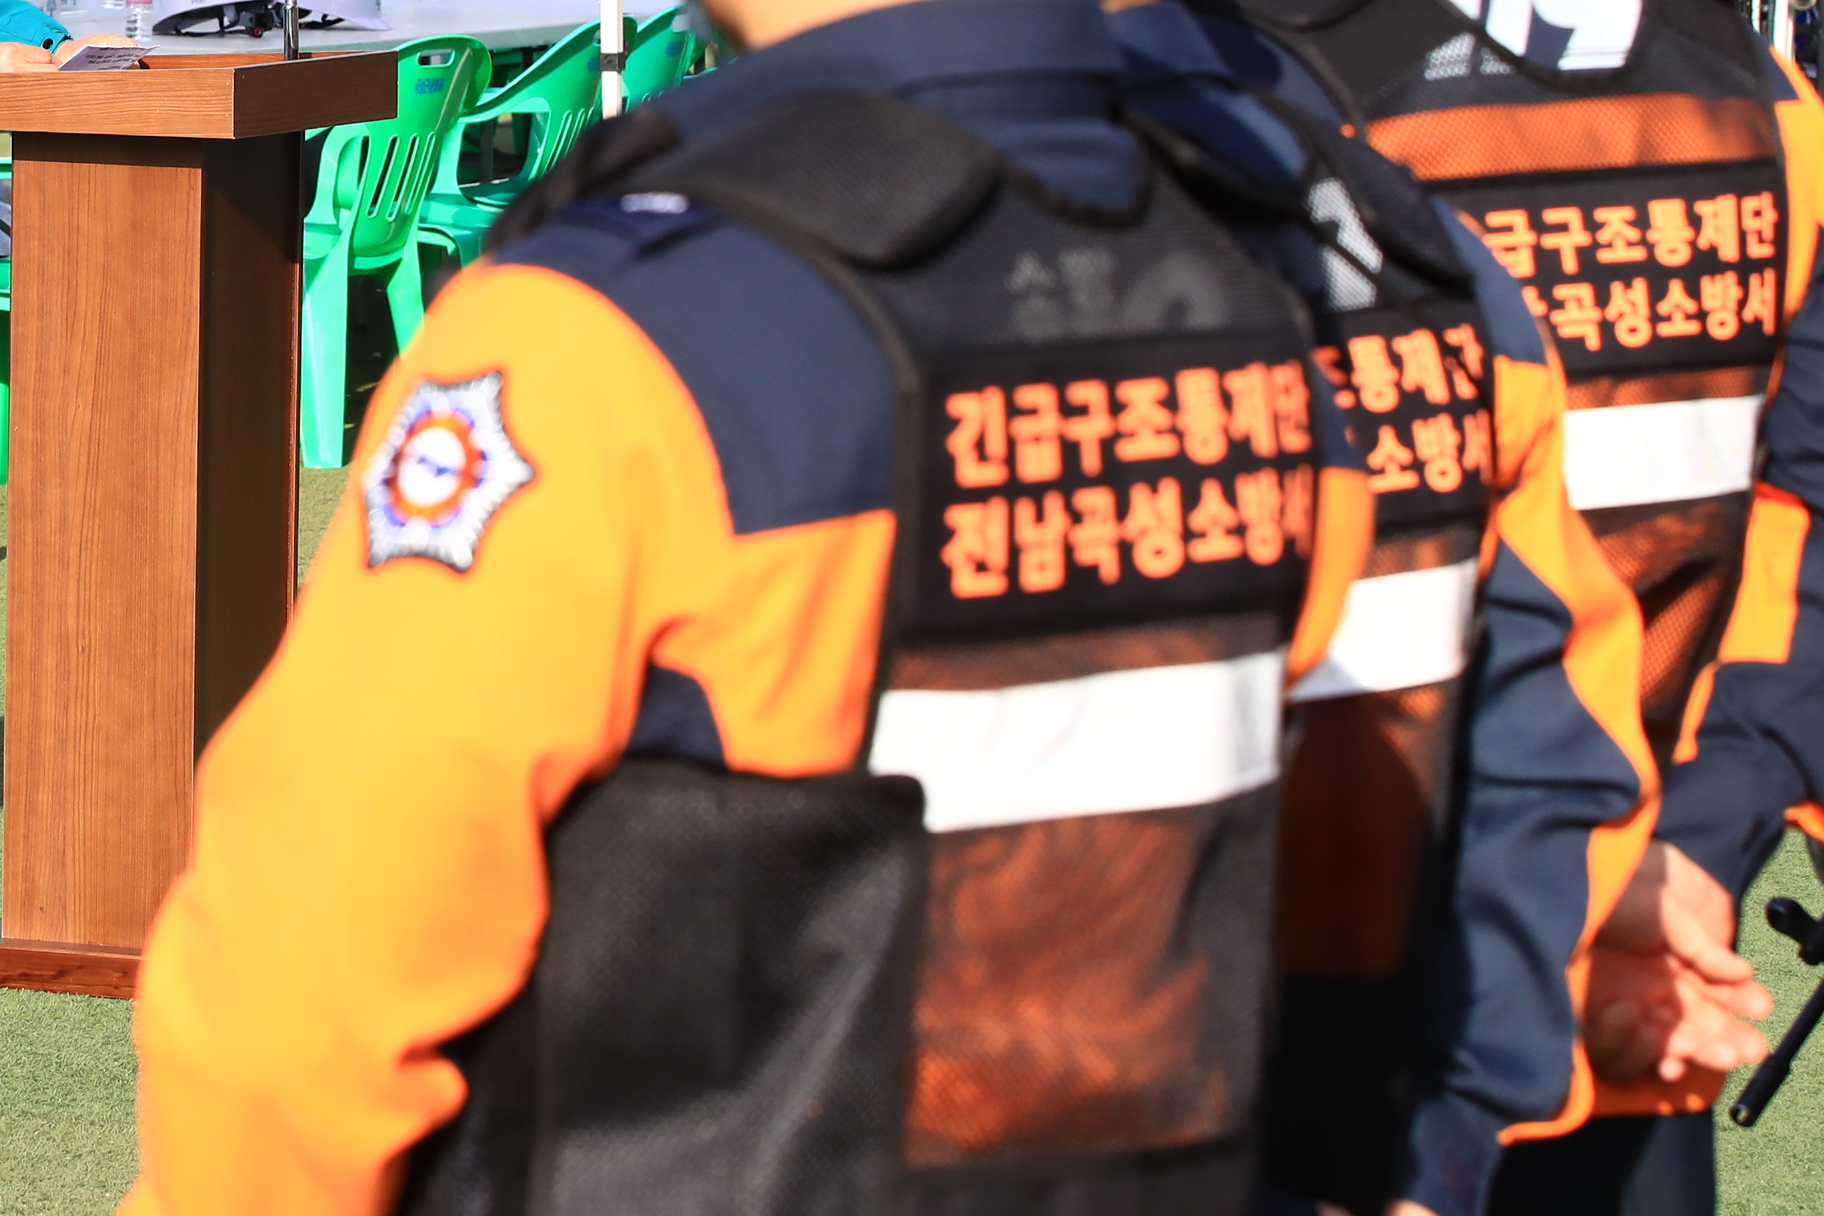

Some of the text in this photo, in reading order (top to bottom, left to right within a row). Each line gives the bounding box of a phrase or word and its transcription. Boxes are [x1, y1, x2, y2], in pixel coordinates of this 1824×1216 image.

[1521, 268, 1777, 352] 곡성소방서
[944, 358, 1314, 491] 긴급구조통제단
[940, 463, 1315, 600] 전남곡성소방서
